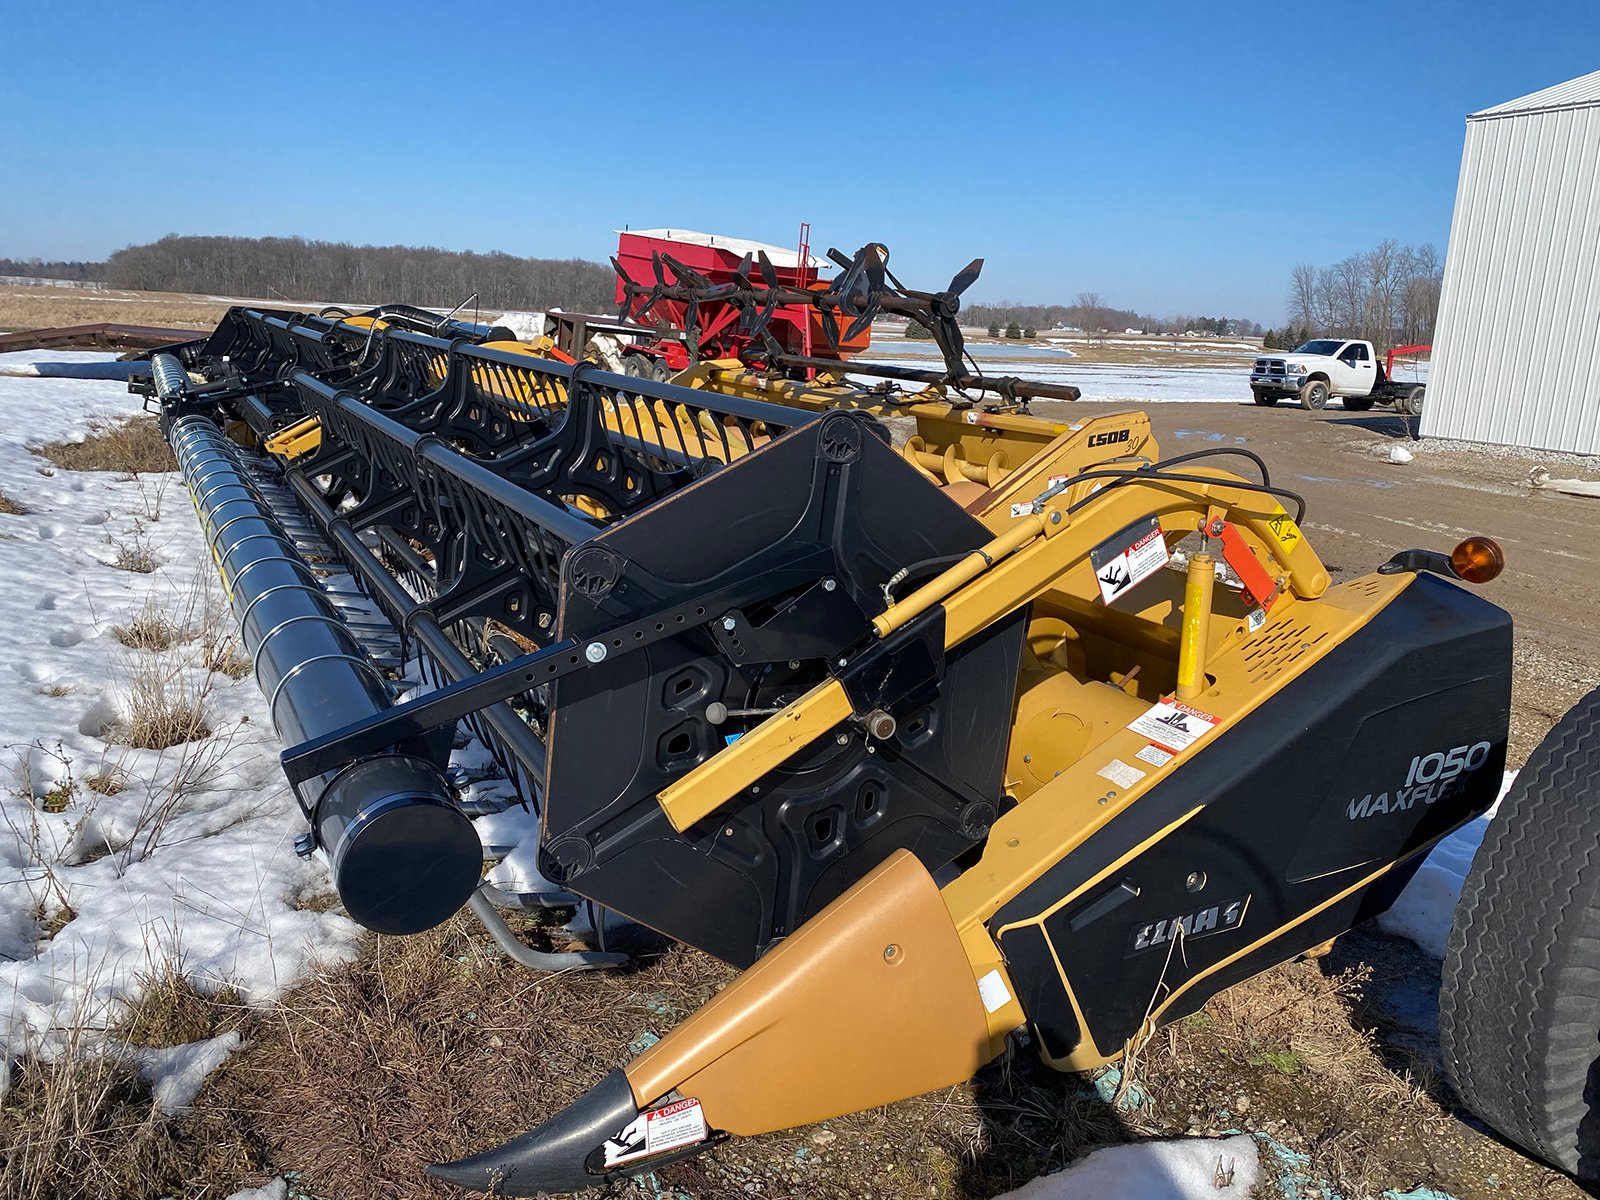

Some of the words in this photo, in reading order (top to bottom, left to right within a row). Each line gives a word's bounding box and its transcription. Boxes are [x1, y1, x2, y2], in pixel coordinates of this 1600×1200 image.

[1125, 436, 1139, 452] 30
[1134, 528, 1160, 549] DANGER
[1177, 704, 1214, 722] DANGER
[1404, 741, 1491, 787] 1050
[663, 1098, 700, 1116] DANGER
